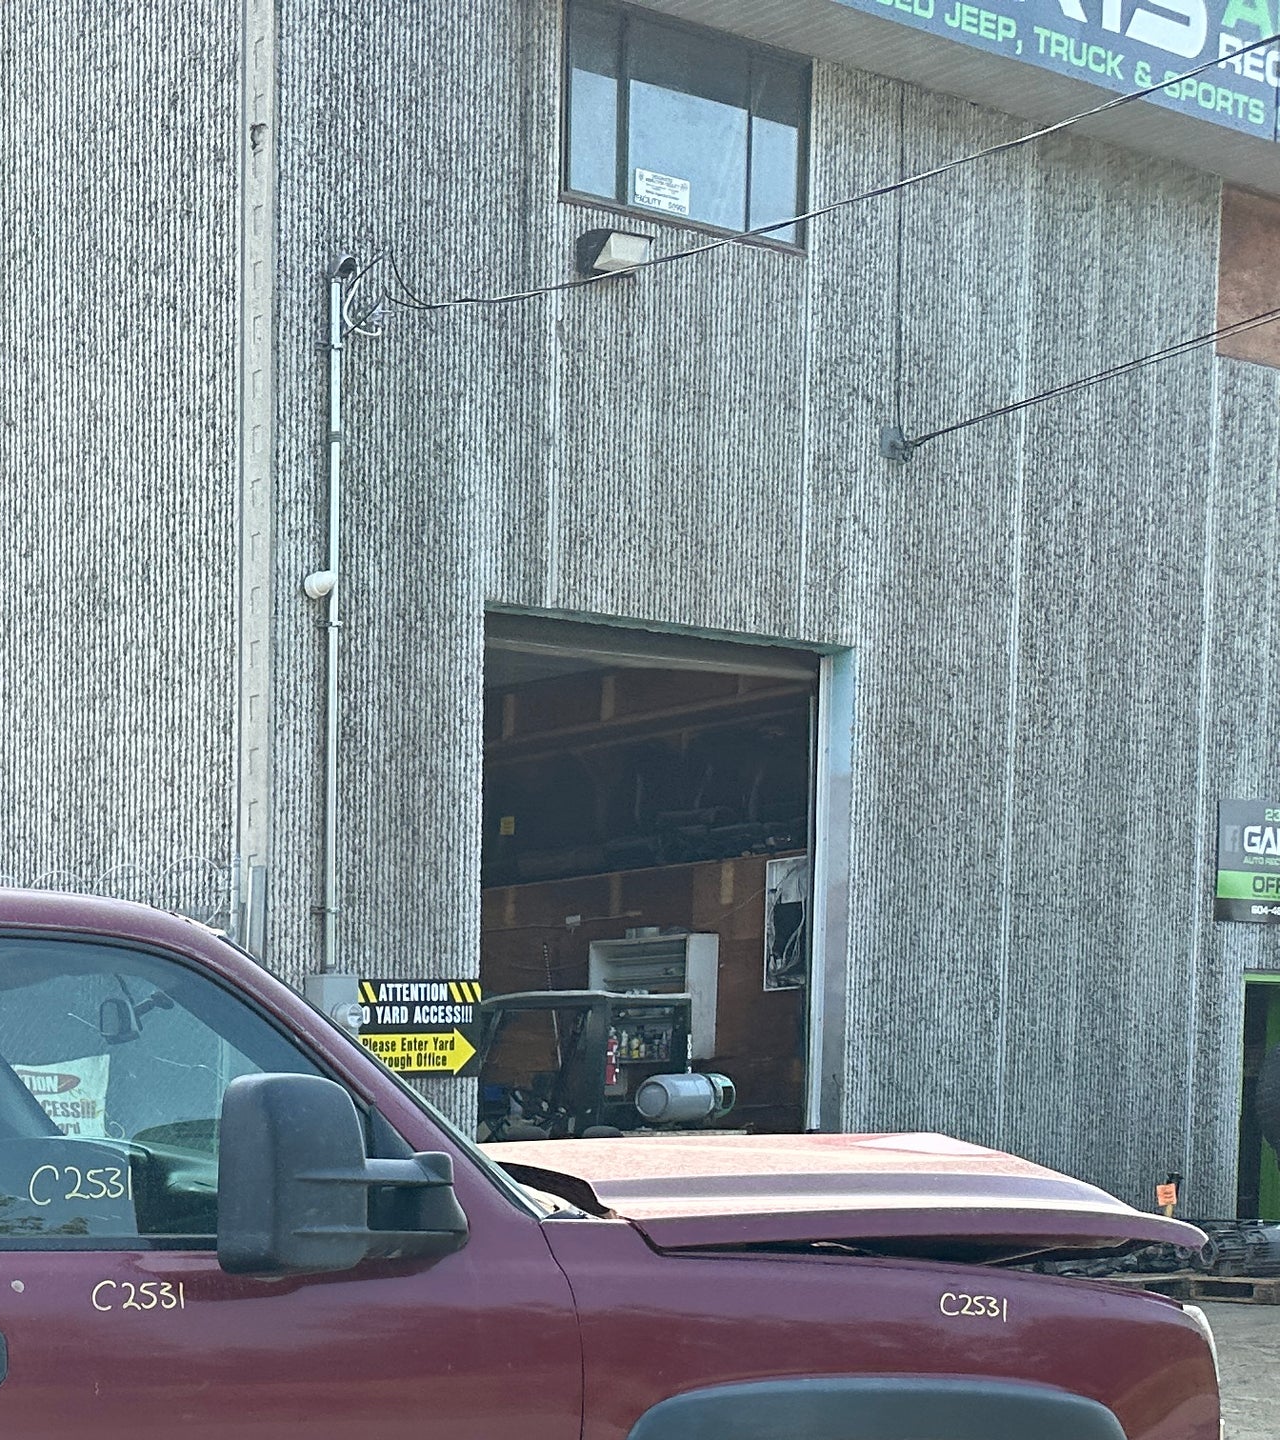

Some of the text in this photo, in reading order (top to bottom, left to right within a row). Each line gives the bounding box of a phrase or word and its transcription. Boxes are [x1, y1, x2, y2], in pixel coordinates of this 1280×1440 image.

[944, 1, 1024, 55] JEEP,
[1033, 25, 1125, 80] TRUCK
[1133, 60, 1153, 89] &
[1162, 69, 1266, 125] SPORTS
[379, 983, 448, 1002] ATTENTION
[375, 1006, 408, 1024] YARD
[413, 1005, 473, 1025] ACCESS!!!
[362, 1036, 455, 1053] Please Enter Yard
[416, 1052, 448, 1067] Office
[28, 1164, 133, 1206] C2531
[91, 1279, 186, 1311] C2531
[940, 1292, 1007, 1322] C2531
